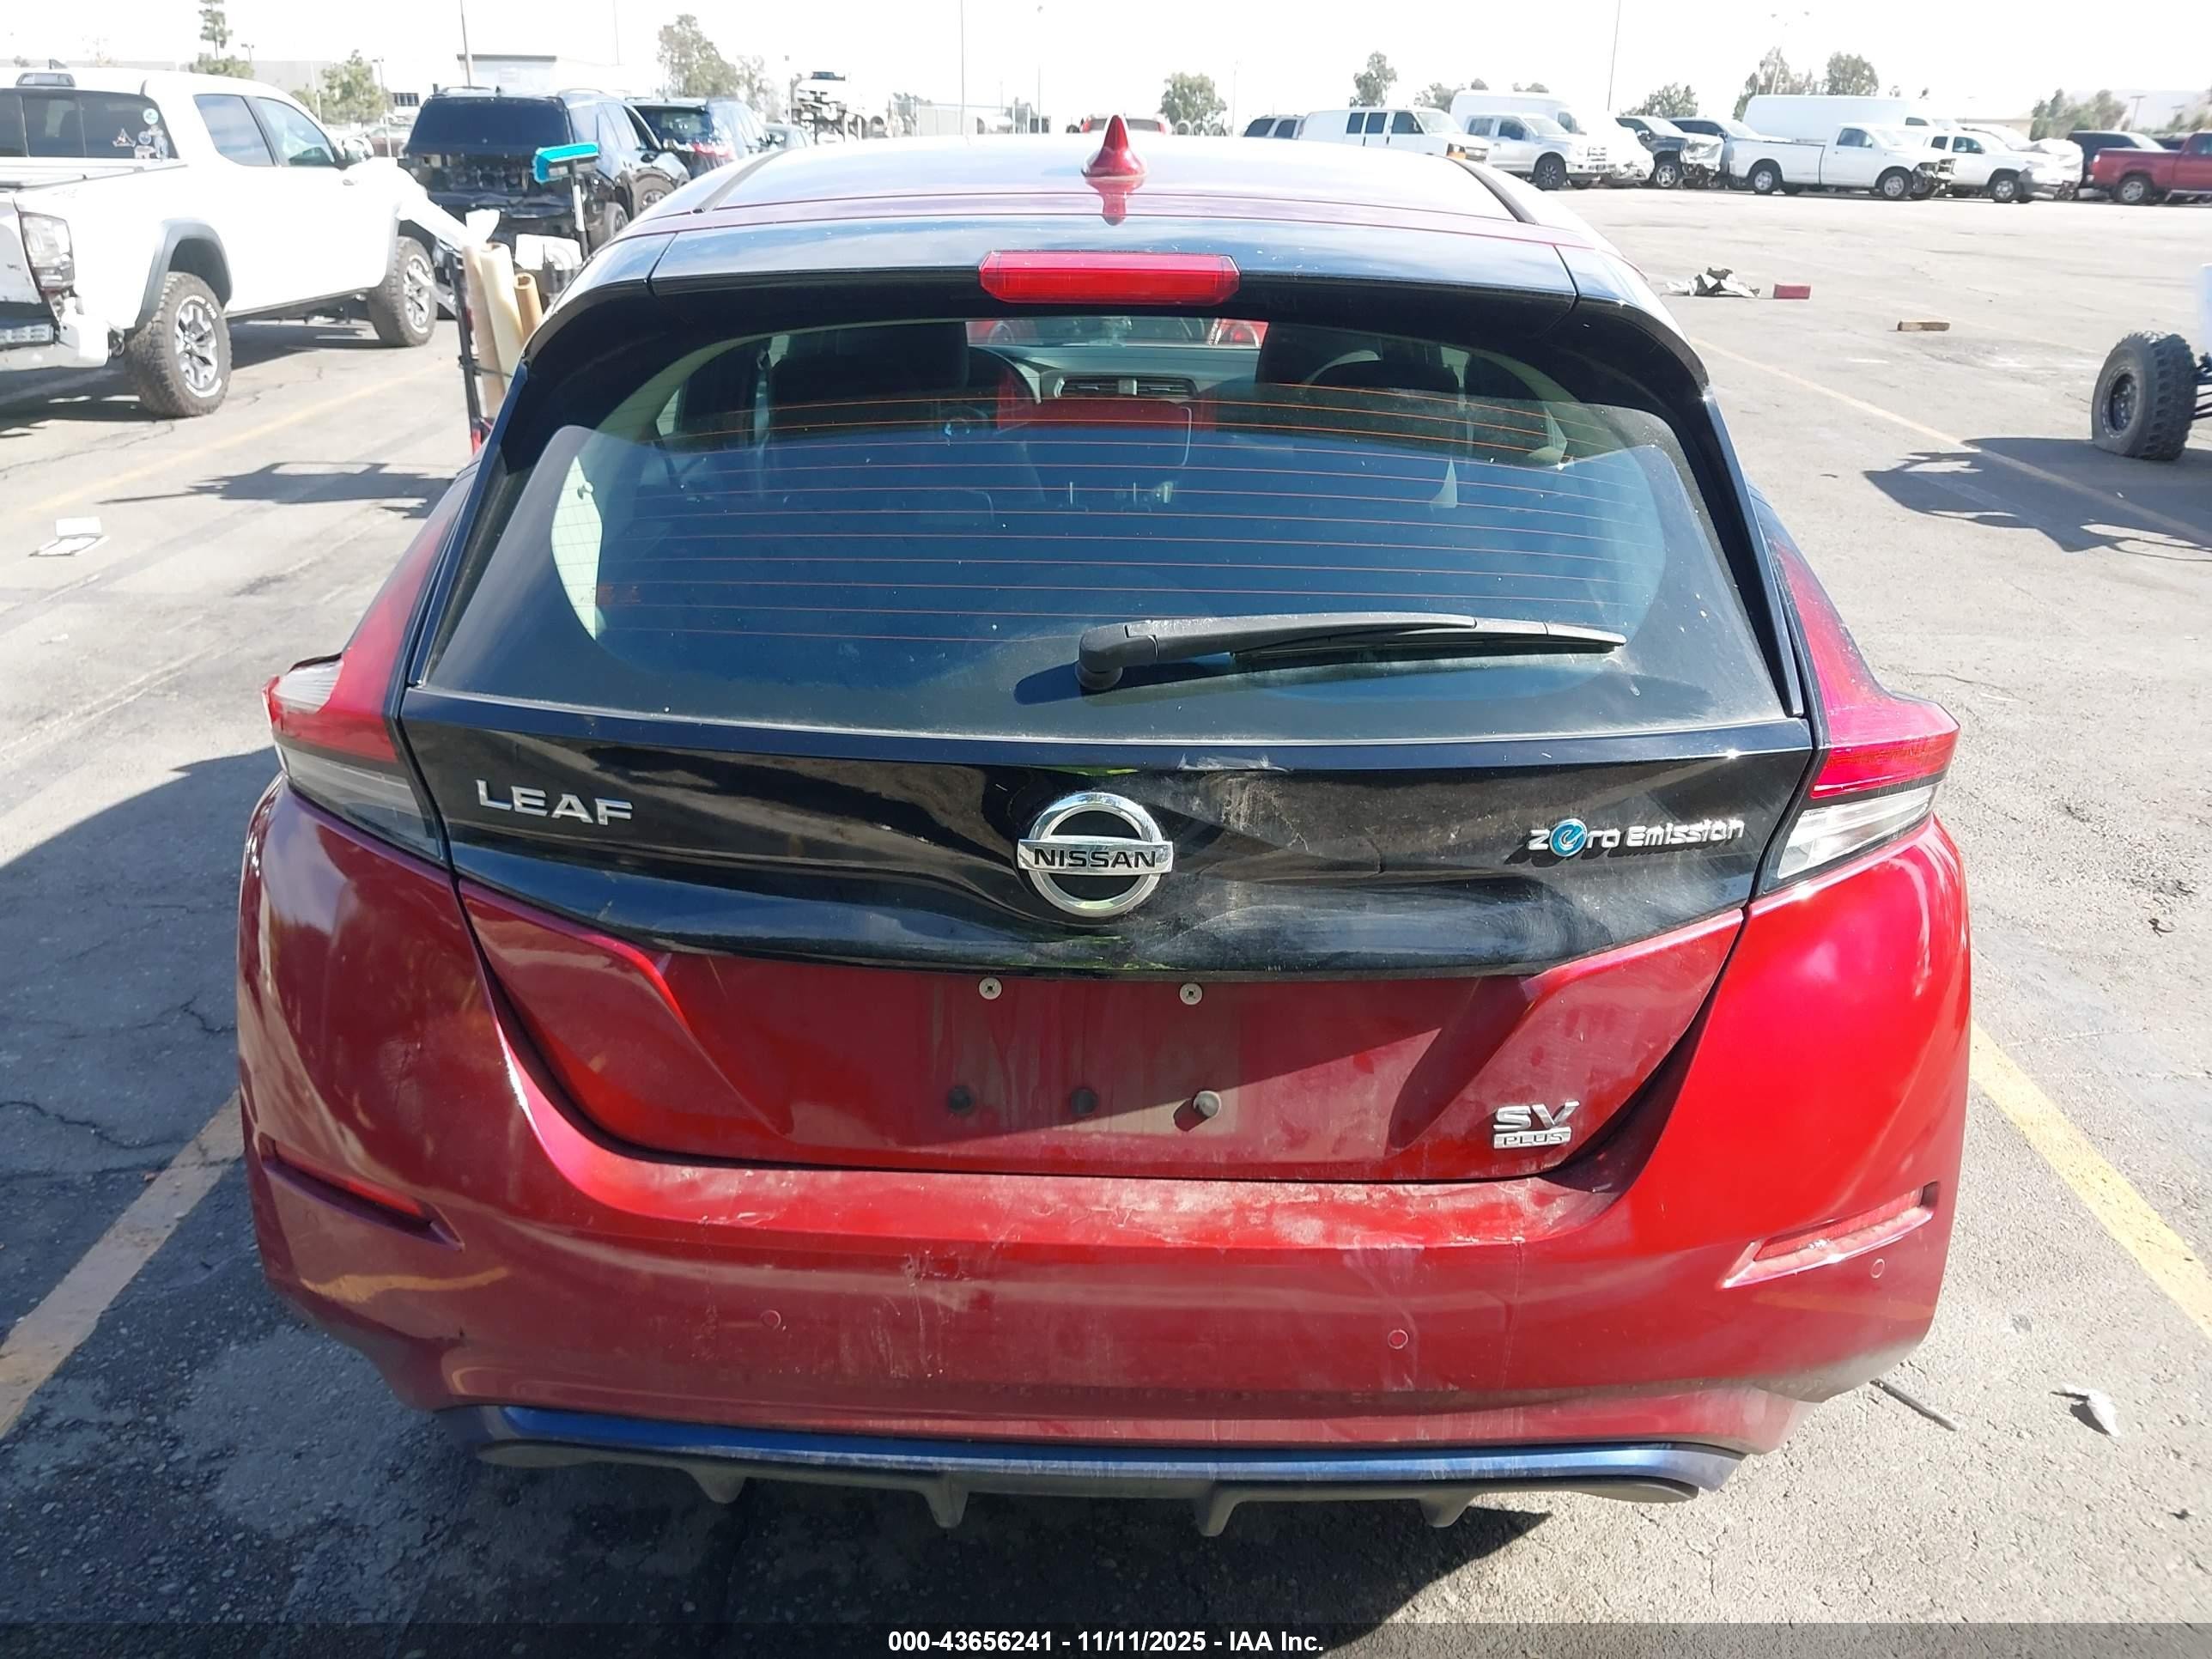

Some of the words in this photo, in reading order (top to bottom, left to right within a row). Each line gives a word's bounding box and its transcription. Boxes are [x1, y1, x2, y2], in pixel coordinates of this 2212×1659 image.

[476, 779, 634, 825] LEAF
[1626, 818, 1747, 848] Emission
[1033, 848, 1157, 869] NISSAN
[1492, 1100, 1581, 1131] SV
[1503, 1133, 1564, 1146] PLUS
